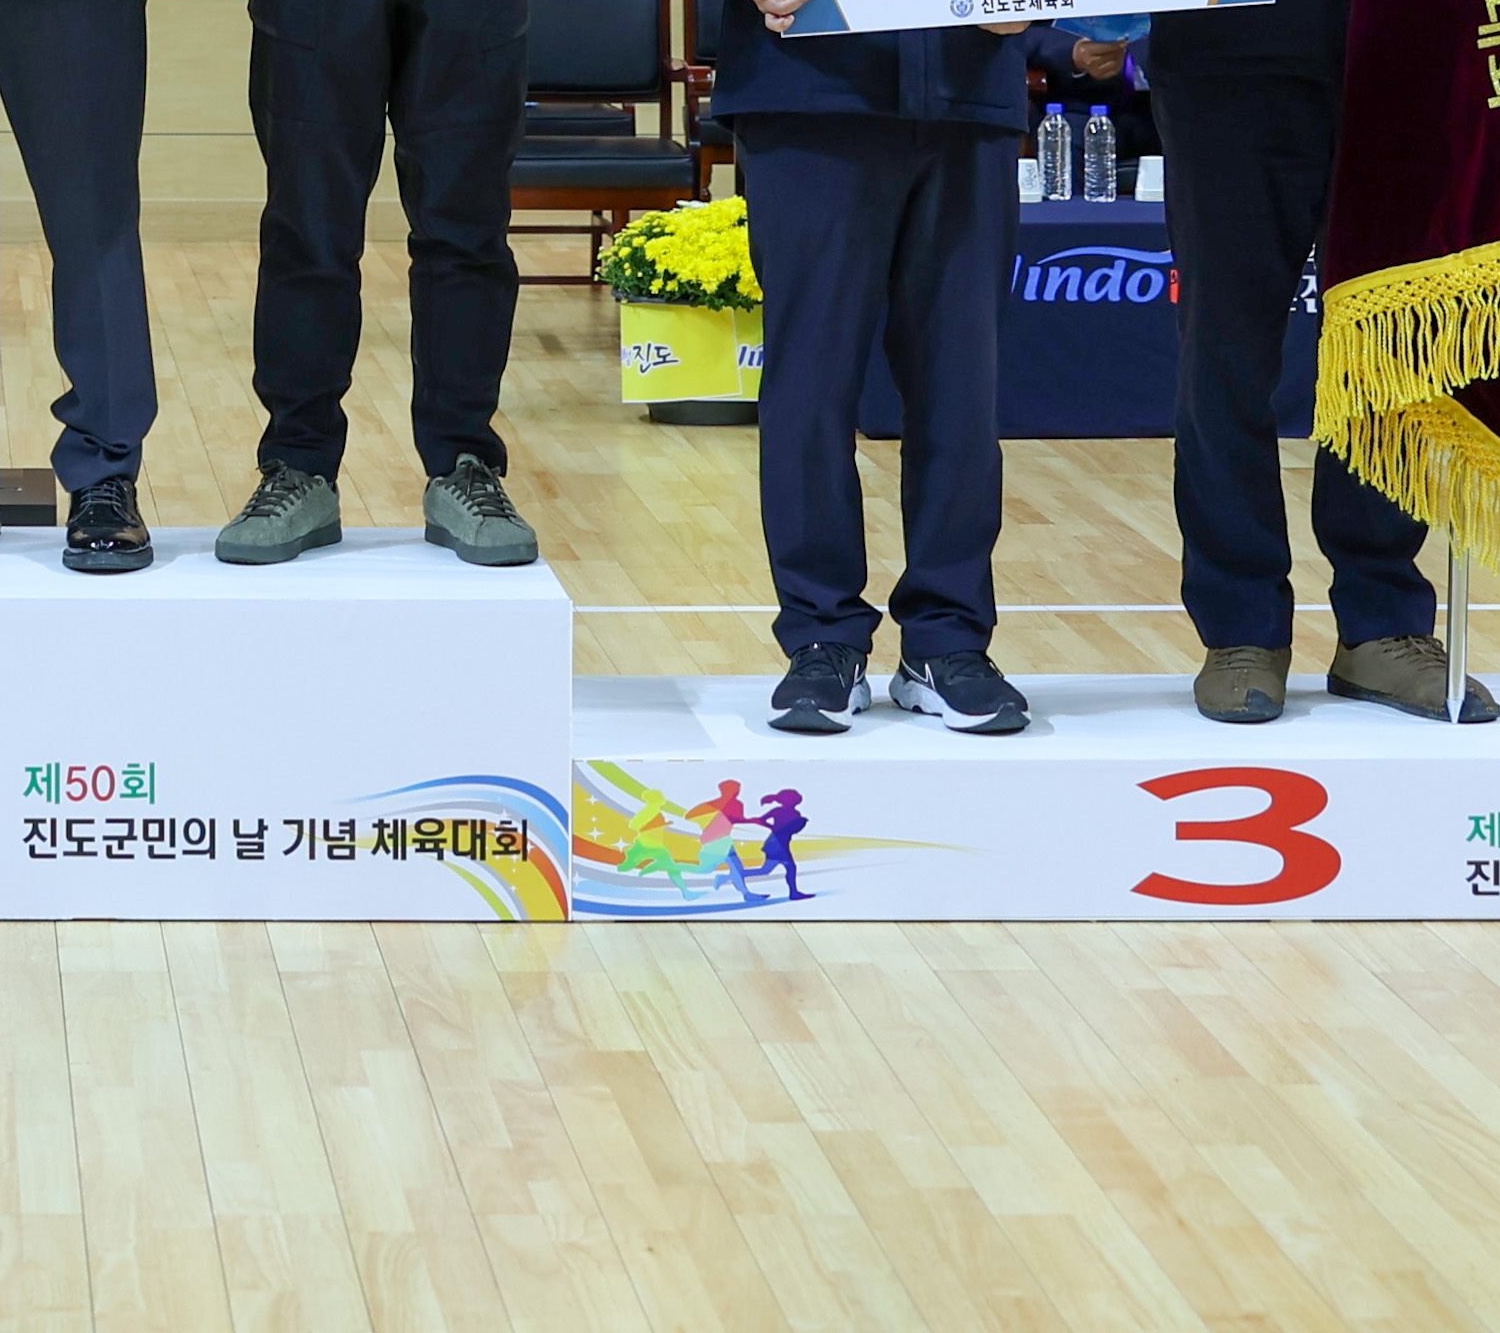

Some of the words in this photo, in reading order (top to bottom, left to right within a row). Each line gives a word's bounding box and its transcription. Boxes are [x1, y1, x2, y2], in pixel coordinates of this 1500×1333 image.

[633, 343, 679, 373] 진도
[22, 763, 158, 806] 제50회
[22, 817, 216, 861] 진도군민의
[232, 817, 269, 861] 날
[282, 817, 357, 861] 기념
[369, 817, 529, 861] 체육대회
[1130, 766, 1342, 907] 3
